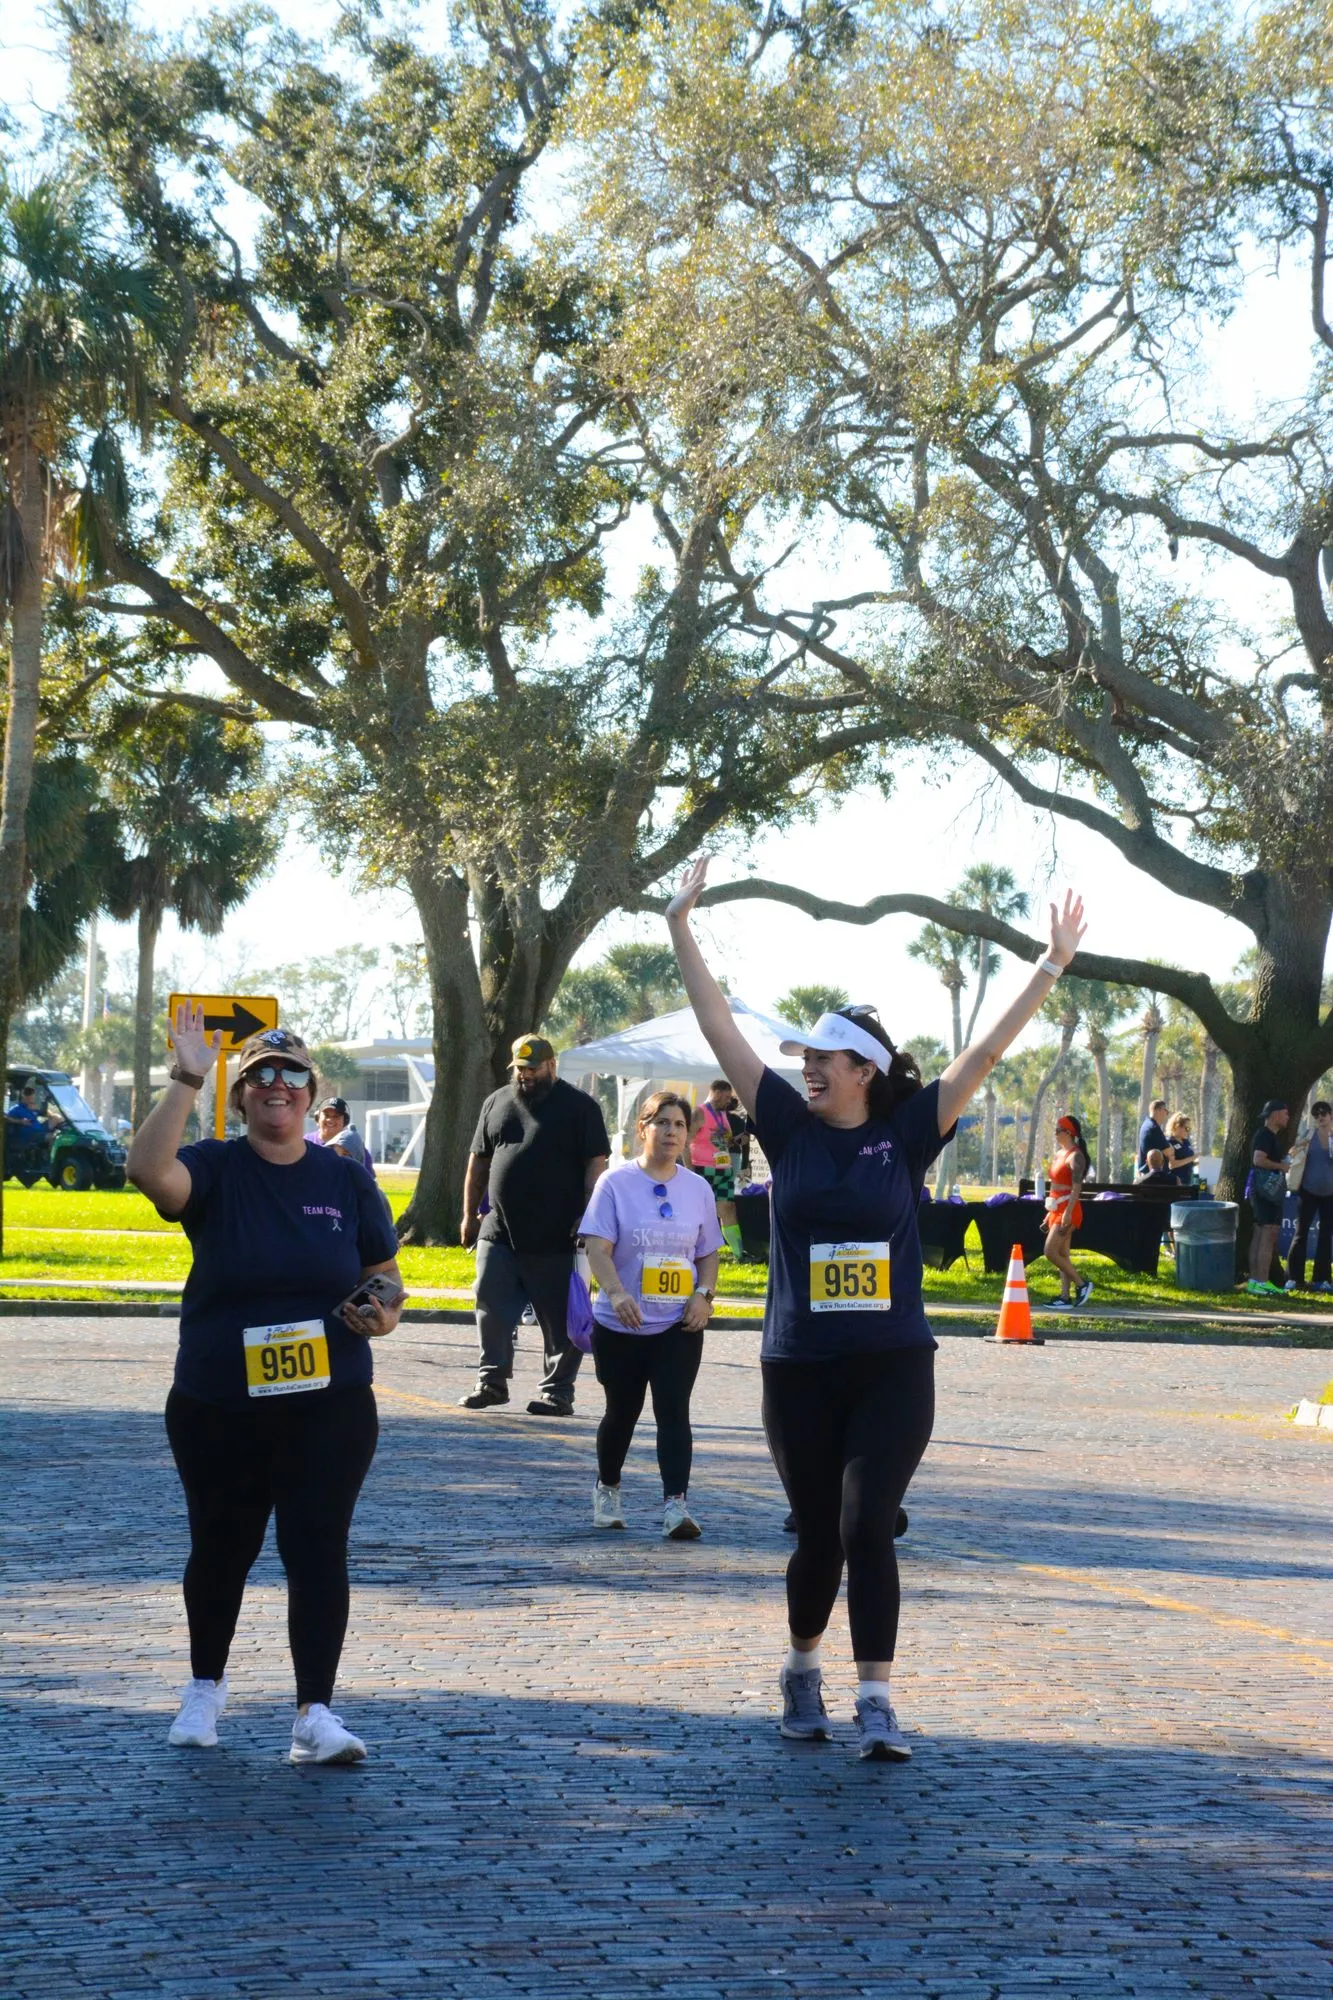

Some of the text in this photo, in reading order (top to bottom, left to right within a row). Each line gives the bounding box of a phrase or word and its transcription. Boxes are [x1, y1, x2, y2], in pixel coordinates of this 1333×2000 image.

[303, 1206, 324, 1215] TEAM
[632, 1228, 651, 1247] 5K
[659, 1271, 680, 1294] 90
[825, 1263, 877, 1298] 953
[261, 1342, 315, 1382] 950
